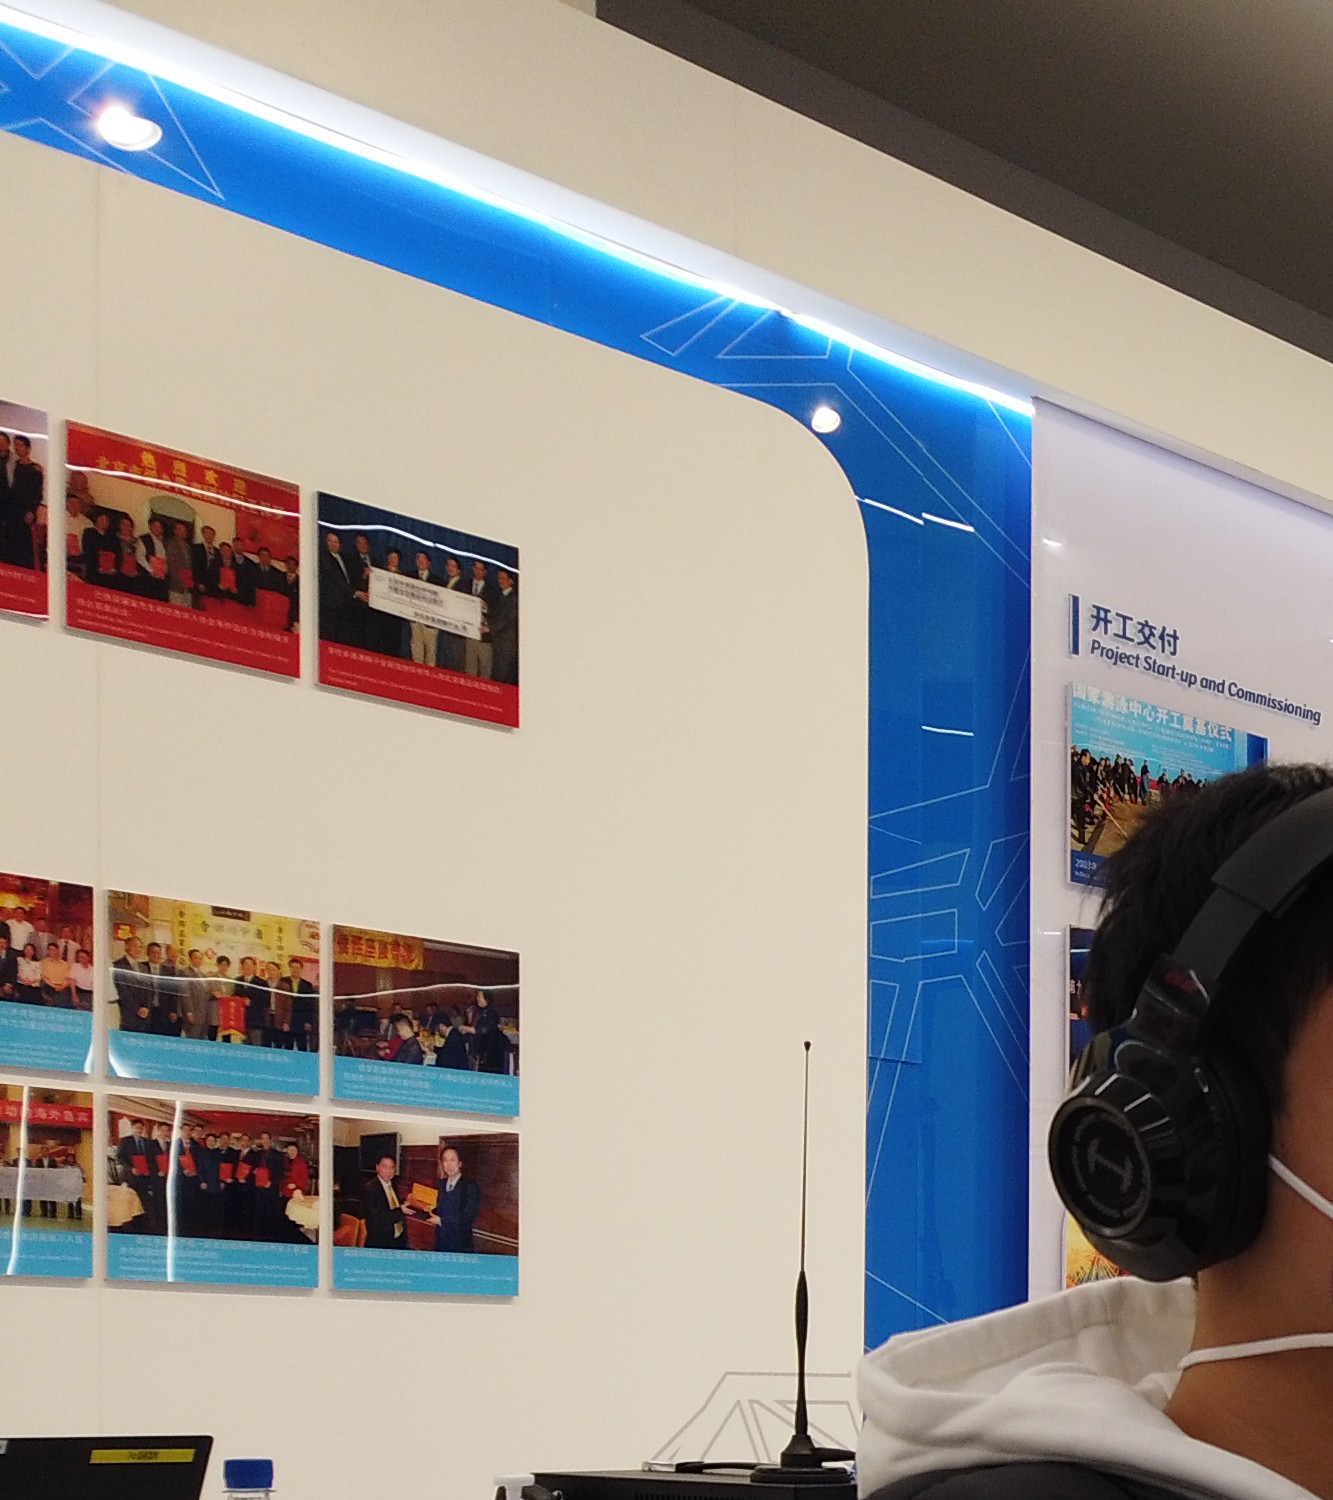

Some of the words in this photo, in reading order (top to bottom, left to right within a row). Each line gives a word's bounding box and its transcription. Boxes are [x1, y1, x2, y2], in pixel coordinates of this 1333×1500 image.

[1090, 604, 1180, 657] 开工交付
[1090, 639, 1140, 669] Project
[1143, 655, 1198, 688] Start-up
[1200, 674, 1225, 695] and
[1228, 682, 1323, 726] Commissioning
